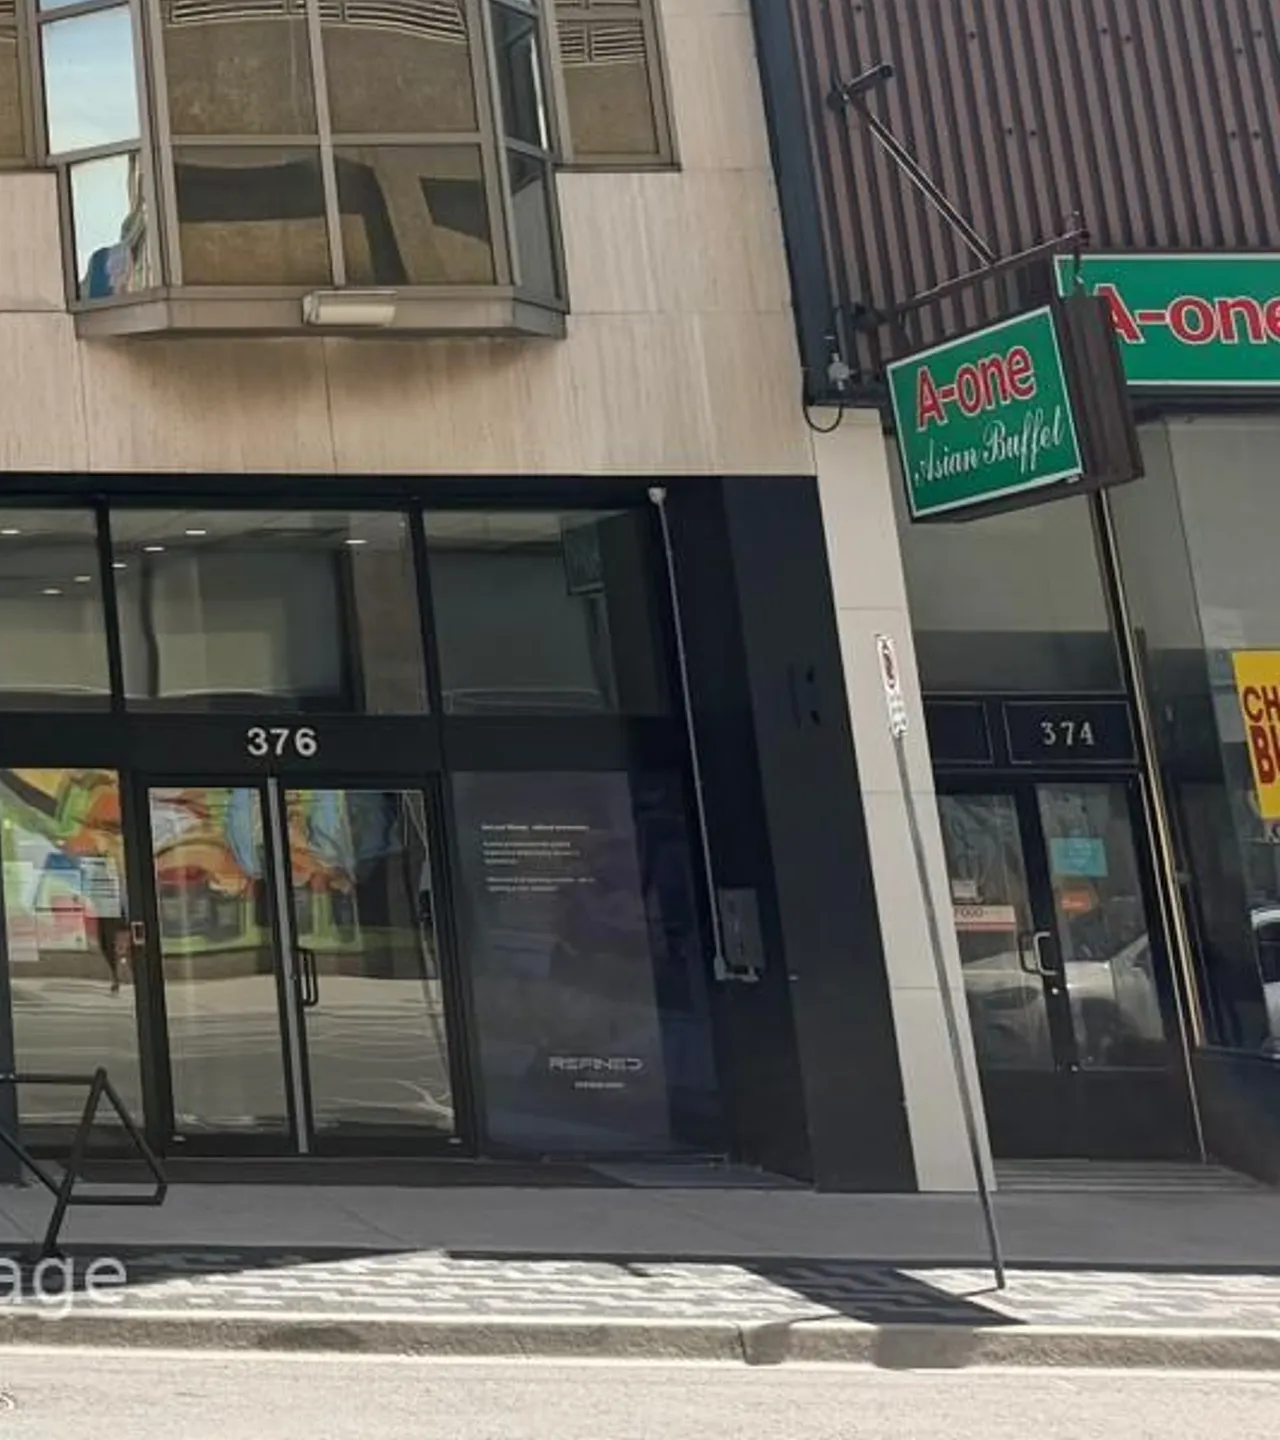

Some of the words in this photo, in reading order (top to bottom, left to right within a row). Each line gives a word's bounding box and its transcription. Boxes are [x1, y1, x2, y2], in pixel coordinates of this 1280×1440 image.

[915, 345, 1037, 433] A-one
[915, 438, 981, 486] Asian
[983, 404, 1065, 475] Buffet
[247, 726, 317, 757] 376
[1040, 721, 1095, 746] 374
